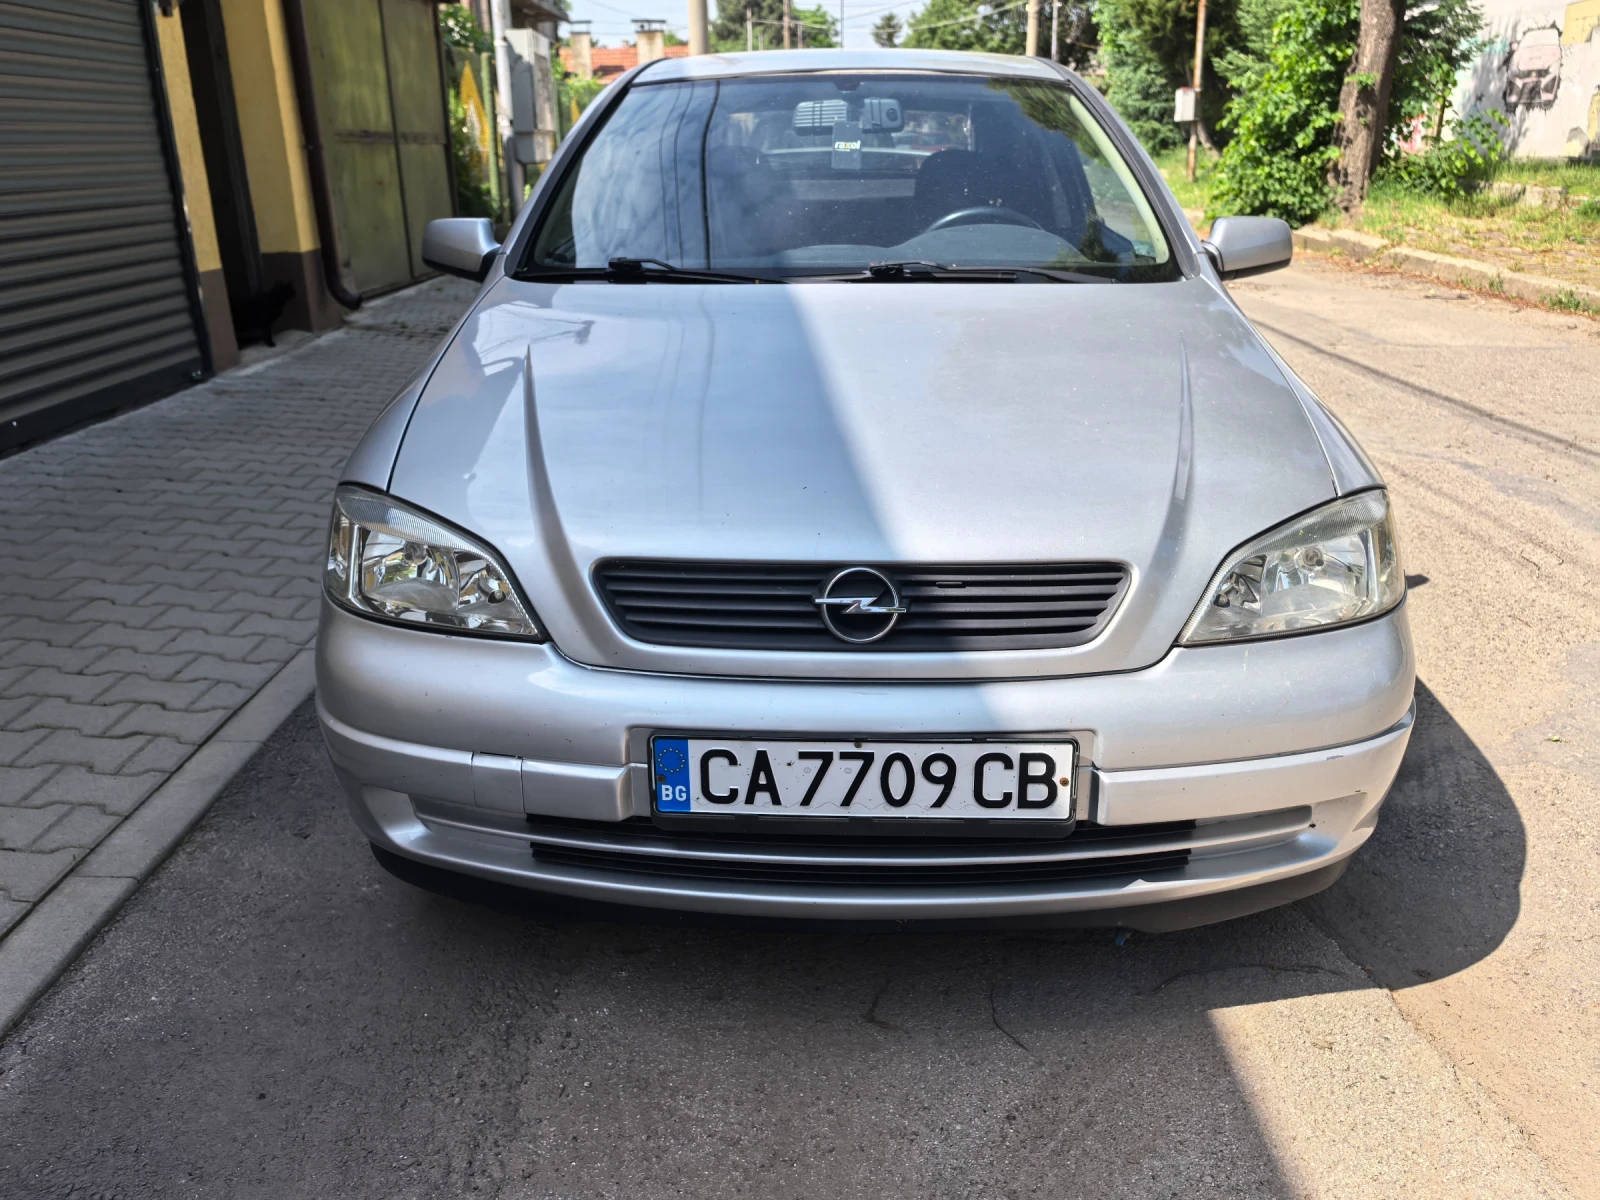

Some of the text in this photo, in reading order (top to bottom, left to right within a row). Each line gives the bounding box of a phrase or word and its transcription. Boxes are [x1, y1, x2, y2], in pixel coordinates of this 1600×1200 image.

[661, 785, 687, 802] BG
[700, 748, 1059, 810] CA 7709 CB
